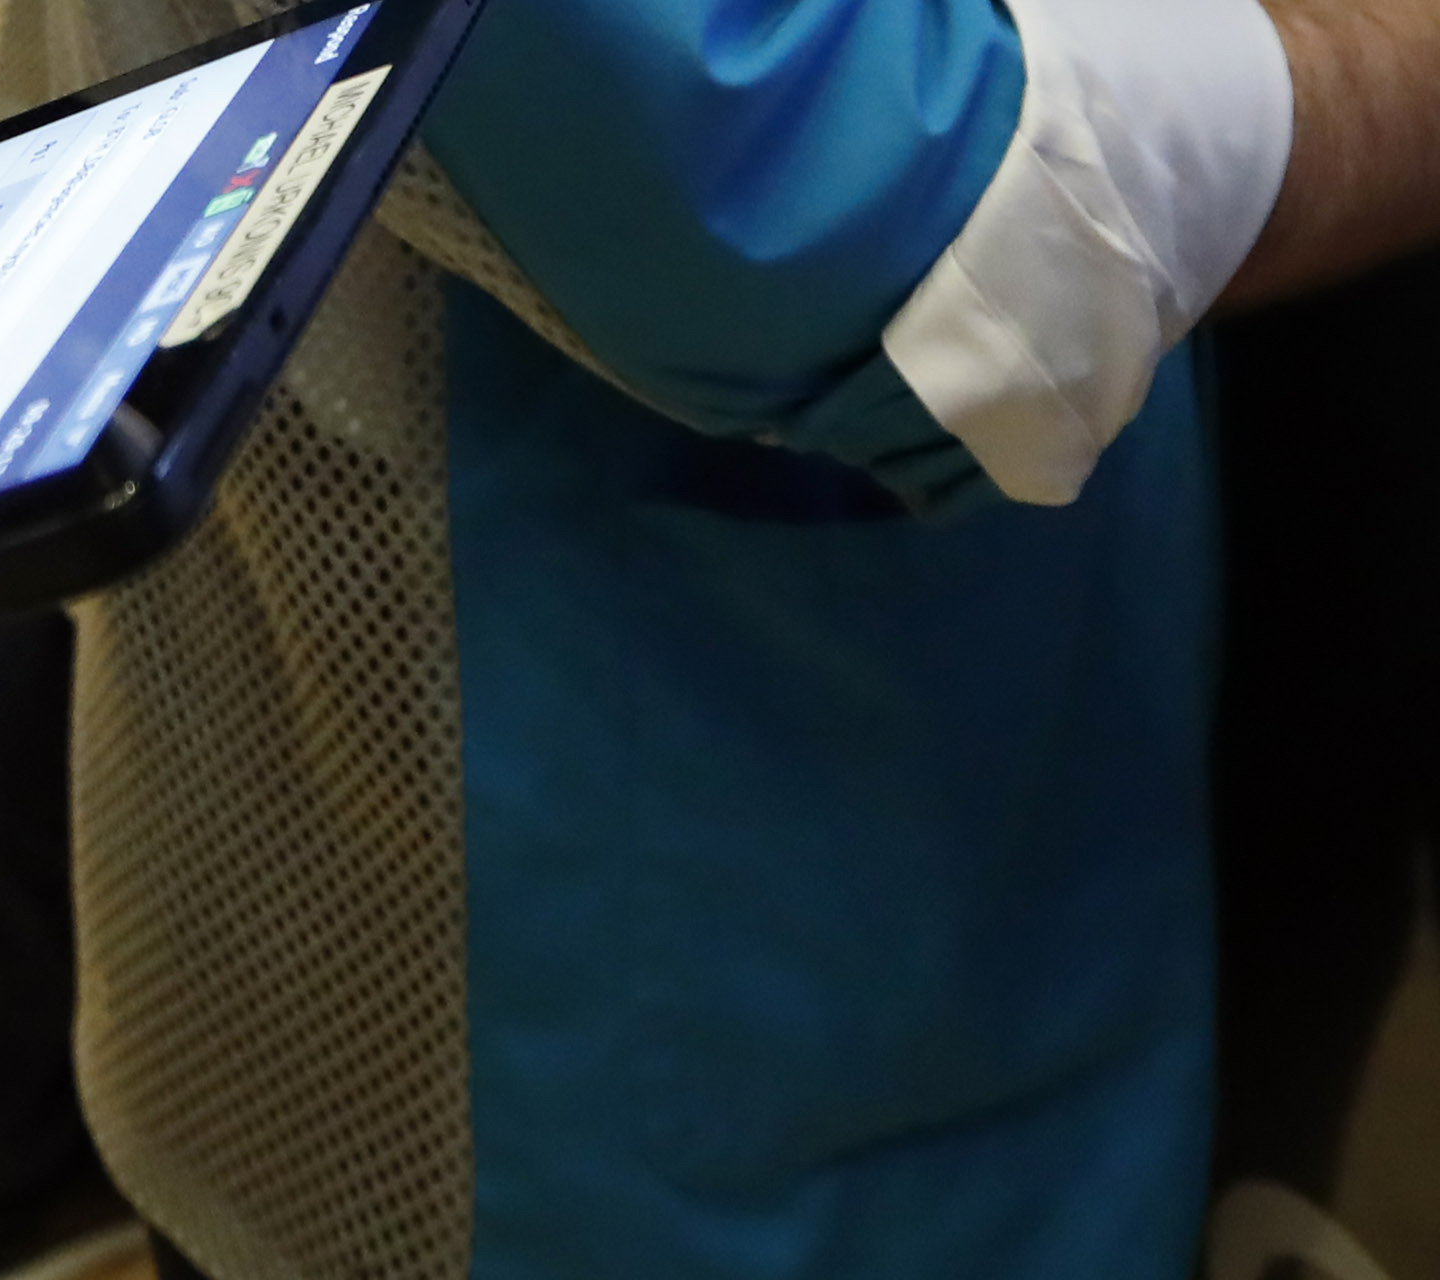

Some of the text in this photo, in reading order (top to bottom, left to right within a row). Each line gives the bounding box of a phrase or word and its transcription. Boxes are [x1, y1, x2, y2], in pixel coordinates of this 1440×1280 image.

[313, 2, 372, 66] Respond
[286, 80, 371, 176] MICHAEL
[219, 173, 311, 281] URKONIS
